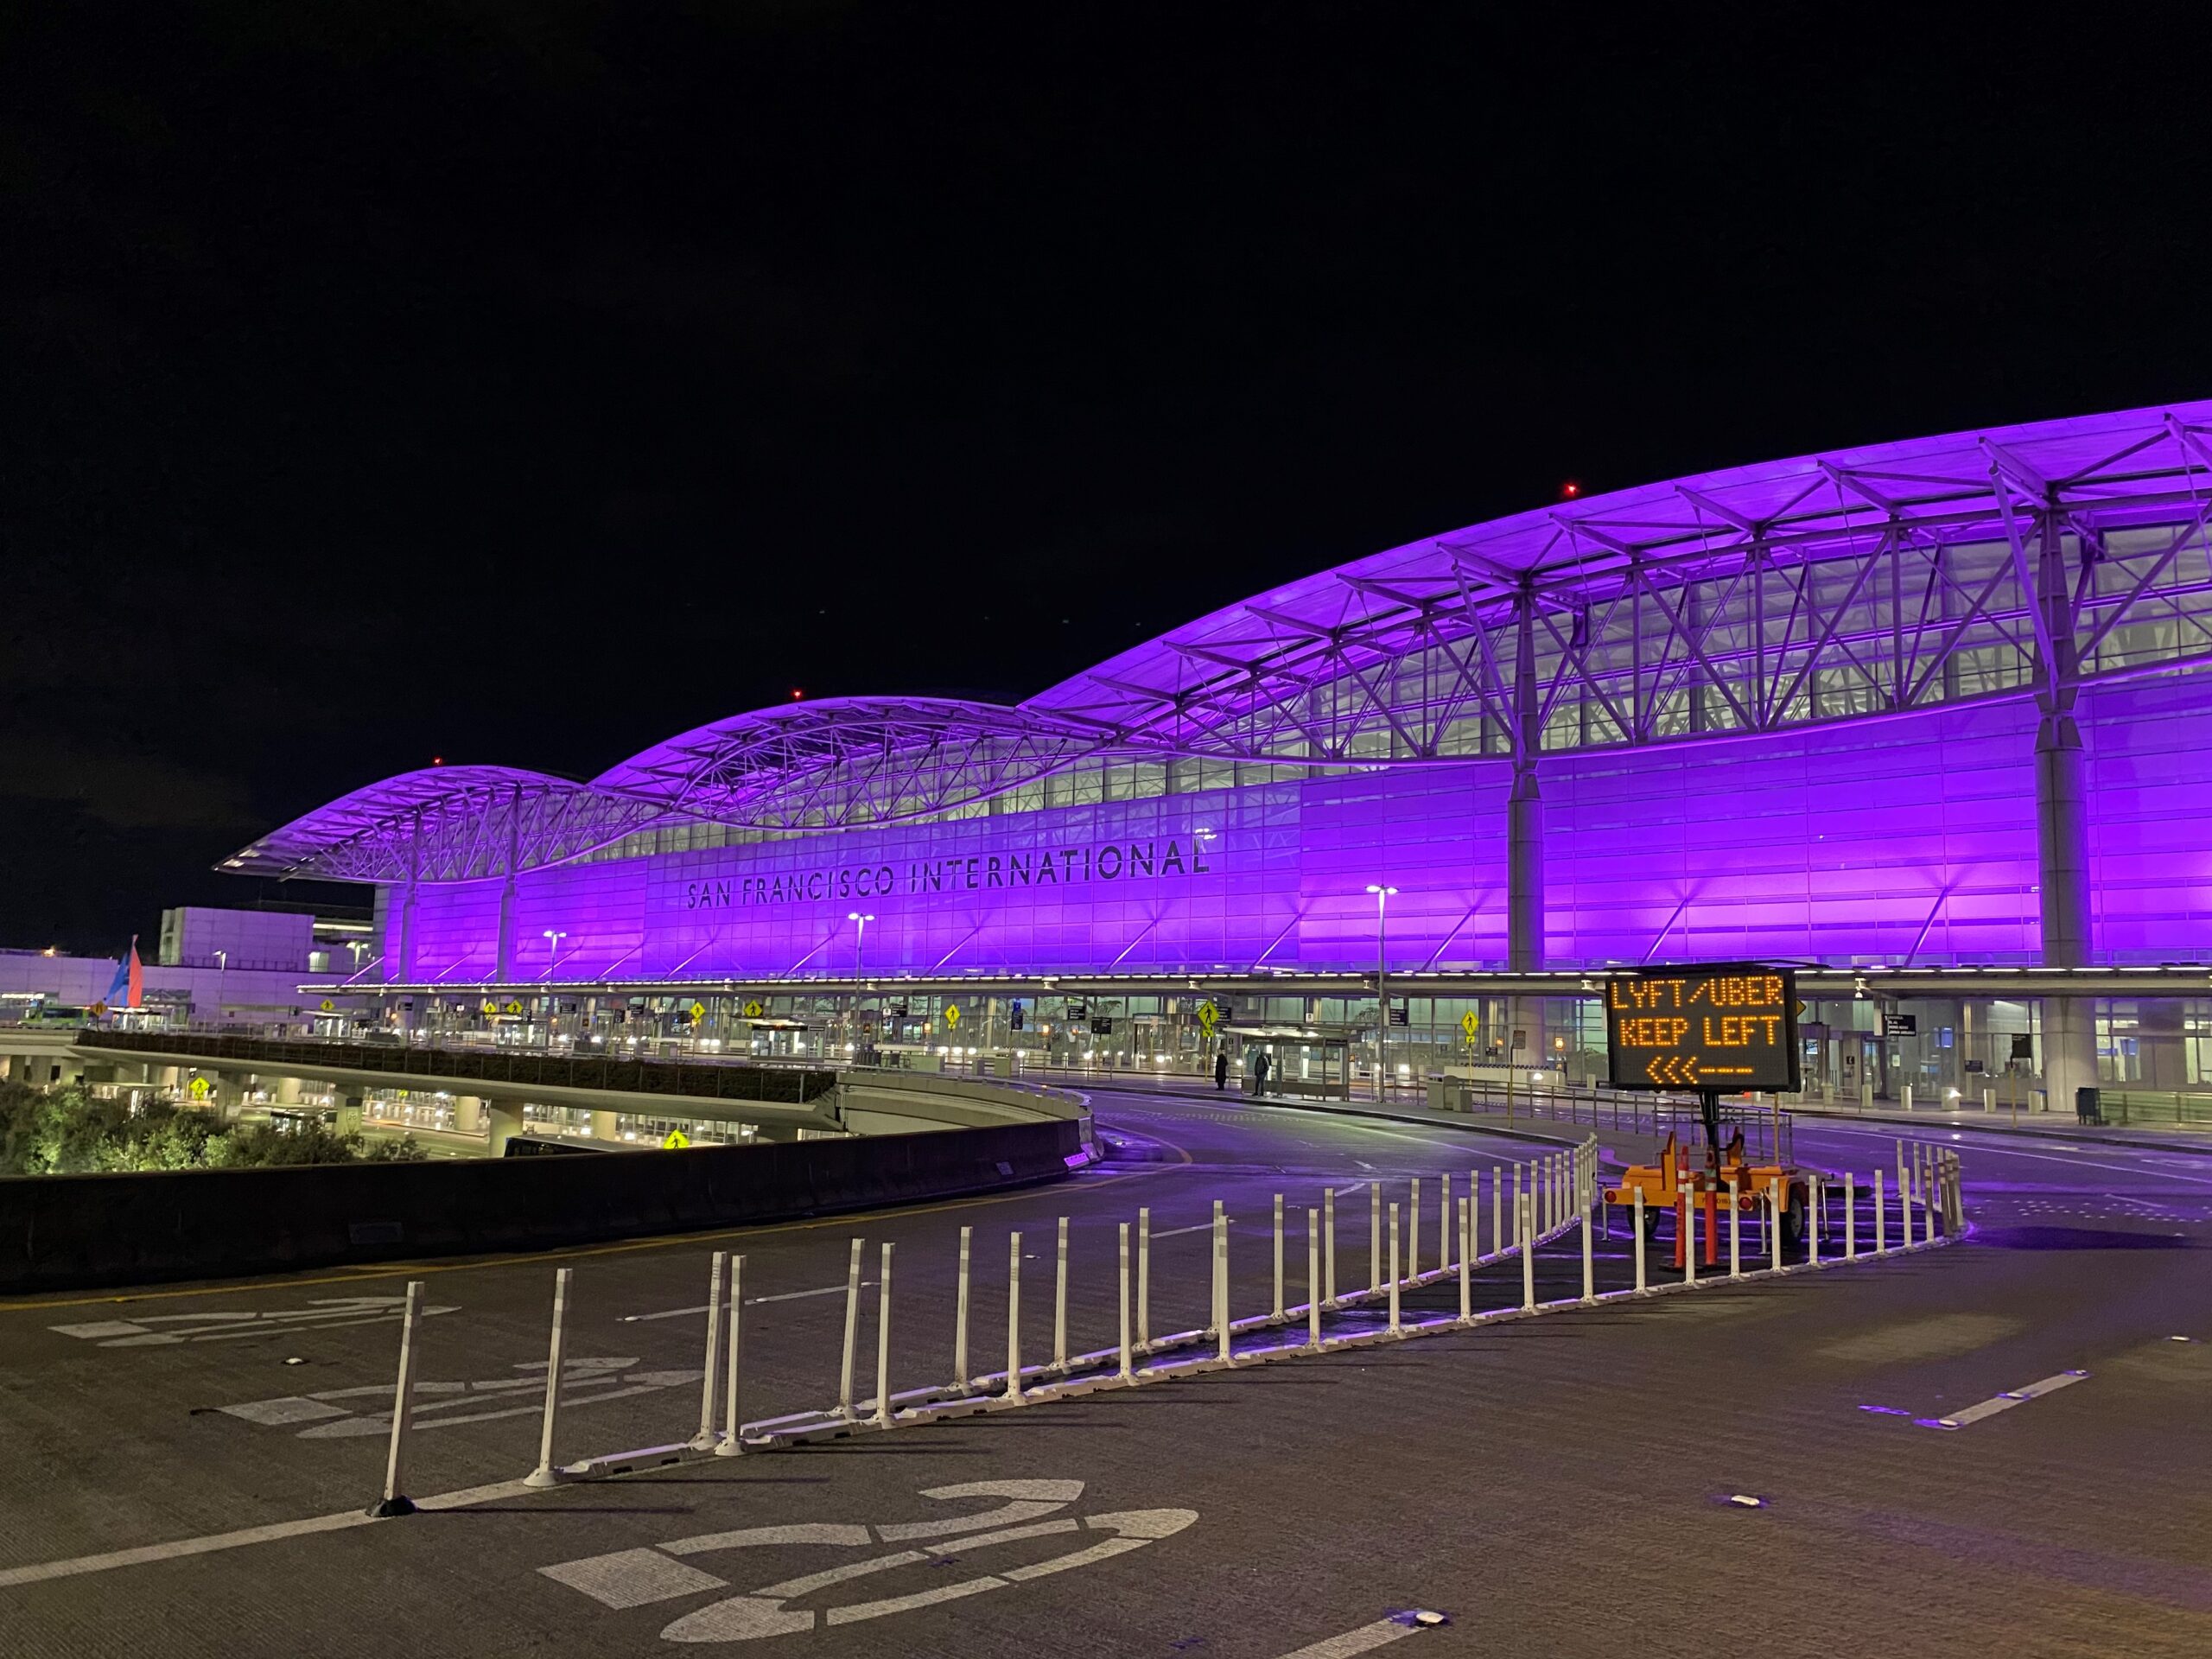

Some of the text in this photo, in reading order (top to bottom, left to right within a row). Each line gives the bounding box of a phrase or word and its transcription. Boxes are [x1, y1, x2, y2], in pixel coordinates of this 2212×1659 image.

[688, 837, 1210, 909] SAN FRANCISCO INTERNATIONAL
[1611, 975, 1784, 1009] LYFT/UBER
[1619, 1014, 1782, 1046] KEEP LEFT
[535, 1478, 1200, 1643] 20
